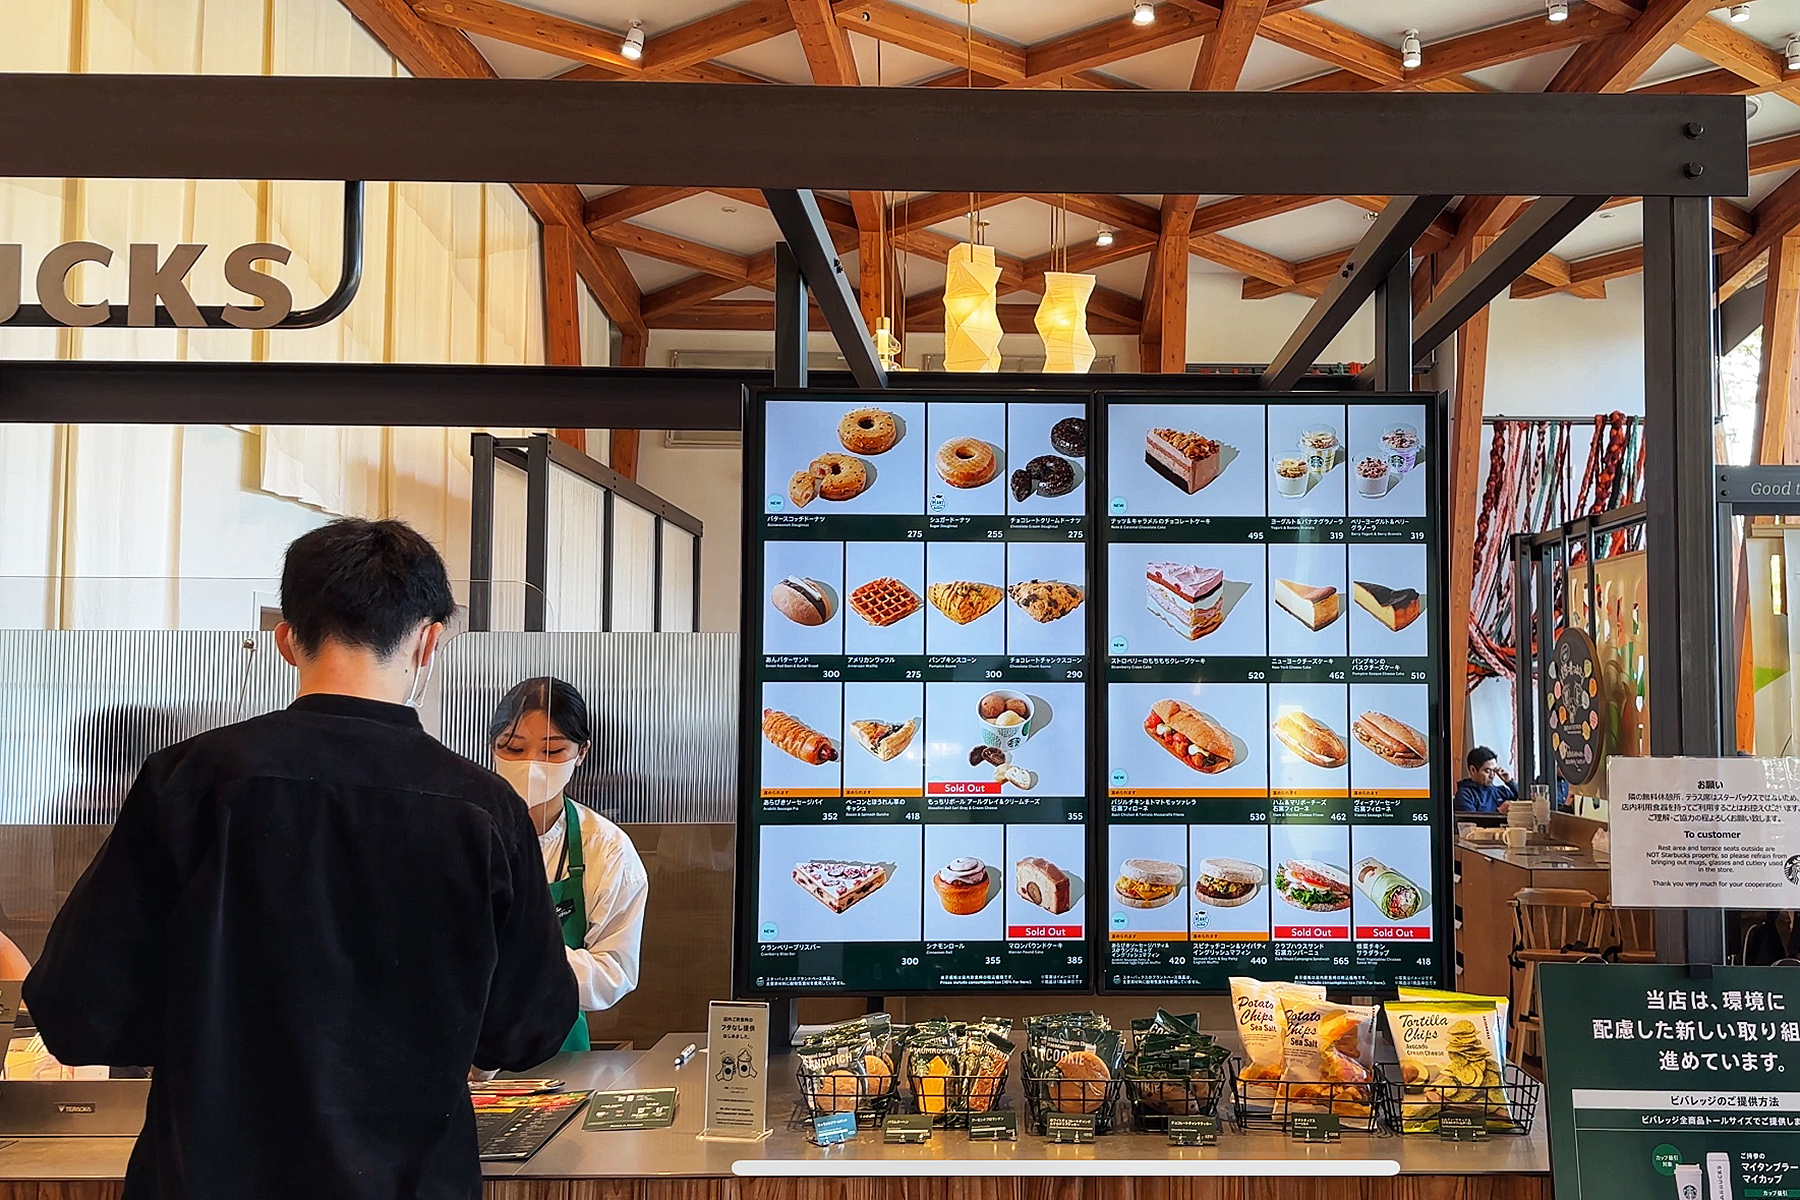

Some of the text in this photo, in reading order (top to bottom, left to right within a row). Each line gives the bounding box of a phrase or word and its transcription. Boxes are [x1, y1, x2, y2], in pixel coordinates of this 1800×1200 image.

[1750, 483, 1791, 497] Good
[822, 670, 840, 678] 300
[1248, 672, 1265, 680] 520
[1411, 672, 1426, 680] 510
[944, 784, 985, 793] Sold Out
[1697, 780, 1724, 790] お願い
[822, 813, 838, 821] 352
[905, 812, 921, 821] 418
[1068, 812, 1083, 821] 355
[1250, 813, 1266, 821] 530
[1330, 813, 1347, 821] 462
[1684, 831, 1741, 839] To customer
[1745, 881, 1783, 889] cooperation!
[1025, 928, 1066, 936] Sold Out
[1291, 928, 1332, 937] Sold Out
[1373, 929, 1414, 938] Sold Out
[901, 957, 919, 965] 300
[1168, 957, 1185, 965] 420
[1250, 957, 1267, 965] 440
[1333, 957, 1349, 965] 565
[1416, 958, 1431, 966] 418
[1238, 996, 1274, 1010] Potato
[1646, 990, 1786, 1012] 当店は、環境に
[1240, 1009, 1274, 1025] Chips
[1399, 1014, 1449, 1028] Tortilla
[1250, 1024, 1263, 1032] Sea
[1592, 1019, 1800, 1042] 配慮した新しい取り組
[1404, 1028, 1440, 1043] Chips
[1290, 1037, 1318, 1048] Sea Salt
[802, 1053, 853, 1070] SANDWICH
[1046, 1048, 1085, 1066] COOKIE
[1659, 1050, 1786, 1073] 進めています。
[1670, 1095, 1780, 1107] ビバレッジのご提供方法
[1741, 1162, 1799, 1172] マイタンブラー
[1742, 1175, 1783, 1184] マイカップ
